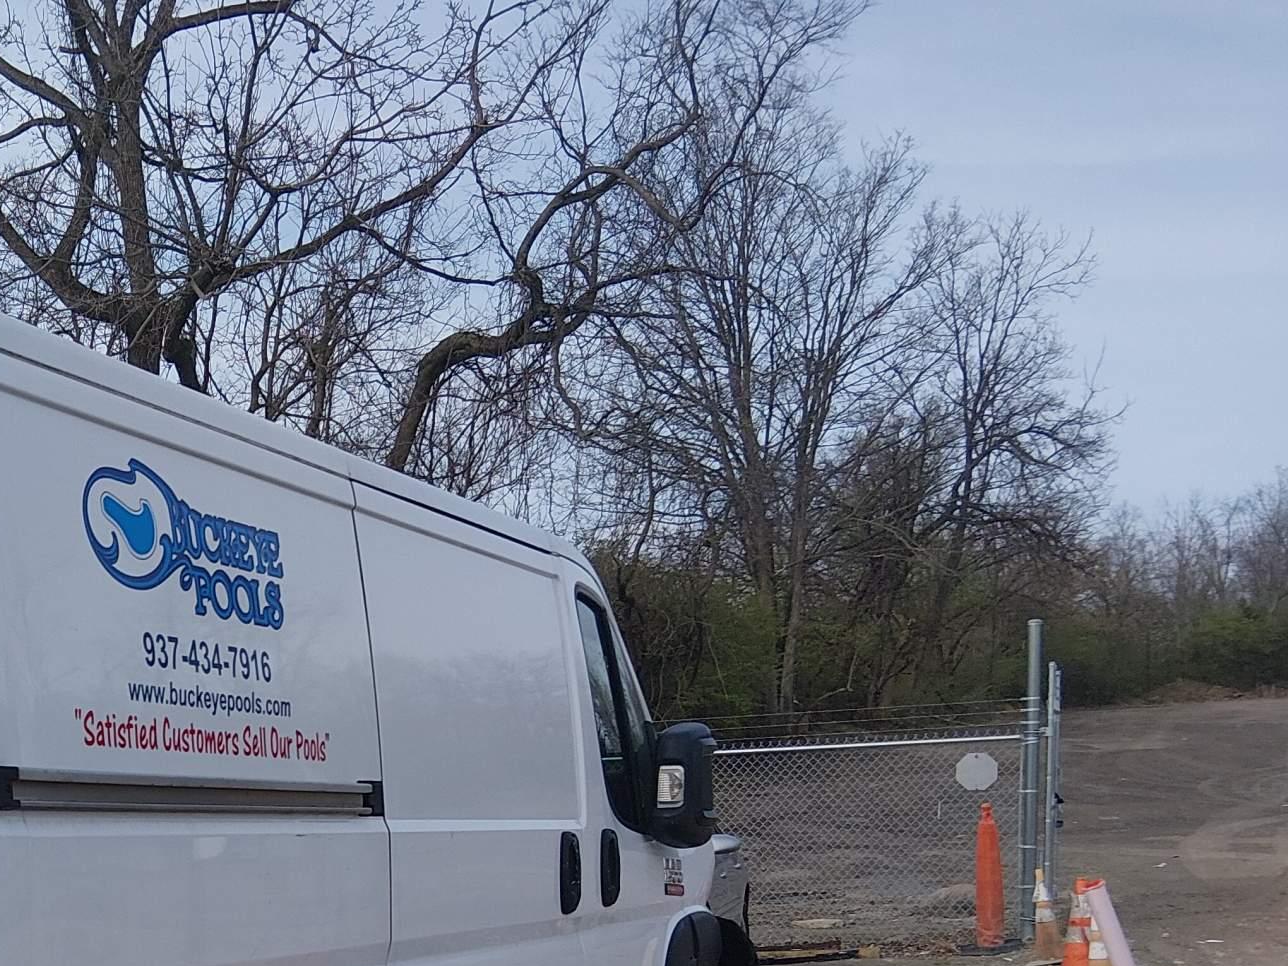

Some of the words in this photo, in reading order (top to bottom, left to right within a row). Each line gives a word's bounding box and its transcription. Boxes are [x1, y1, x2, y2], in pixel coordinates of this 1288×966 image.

[170, 499, 283, 578] BUCKEYE
[180, 564, 283, 630] POOLS
[143, 632, 272, 683] 937-434-7916
[128, 682, 291, 717] www.buckeyepools.com
[74, 708, 158, 750] "Satisfied
[162, 717, 240, 756] Customers
[242, 725, 268, 758] Sell
[270, 726, 294, 760] Our
[295, 729, 330, 762] Pools"
